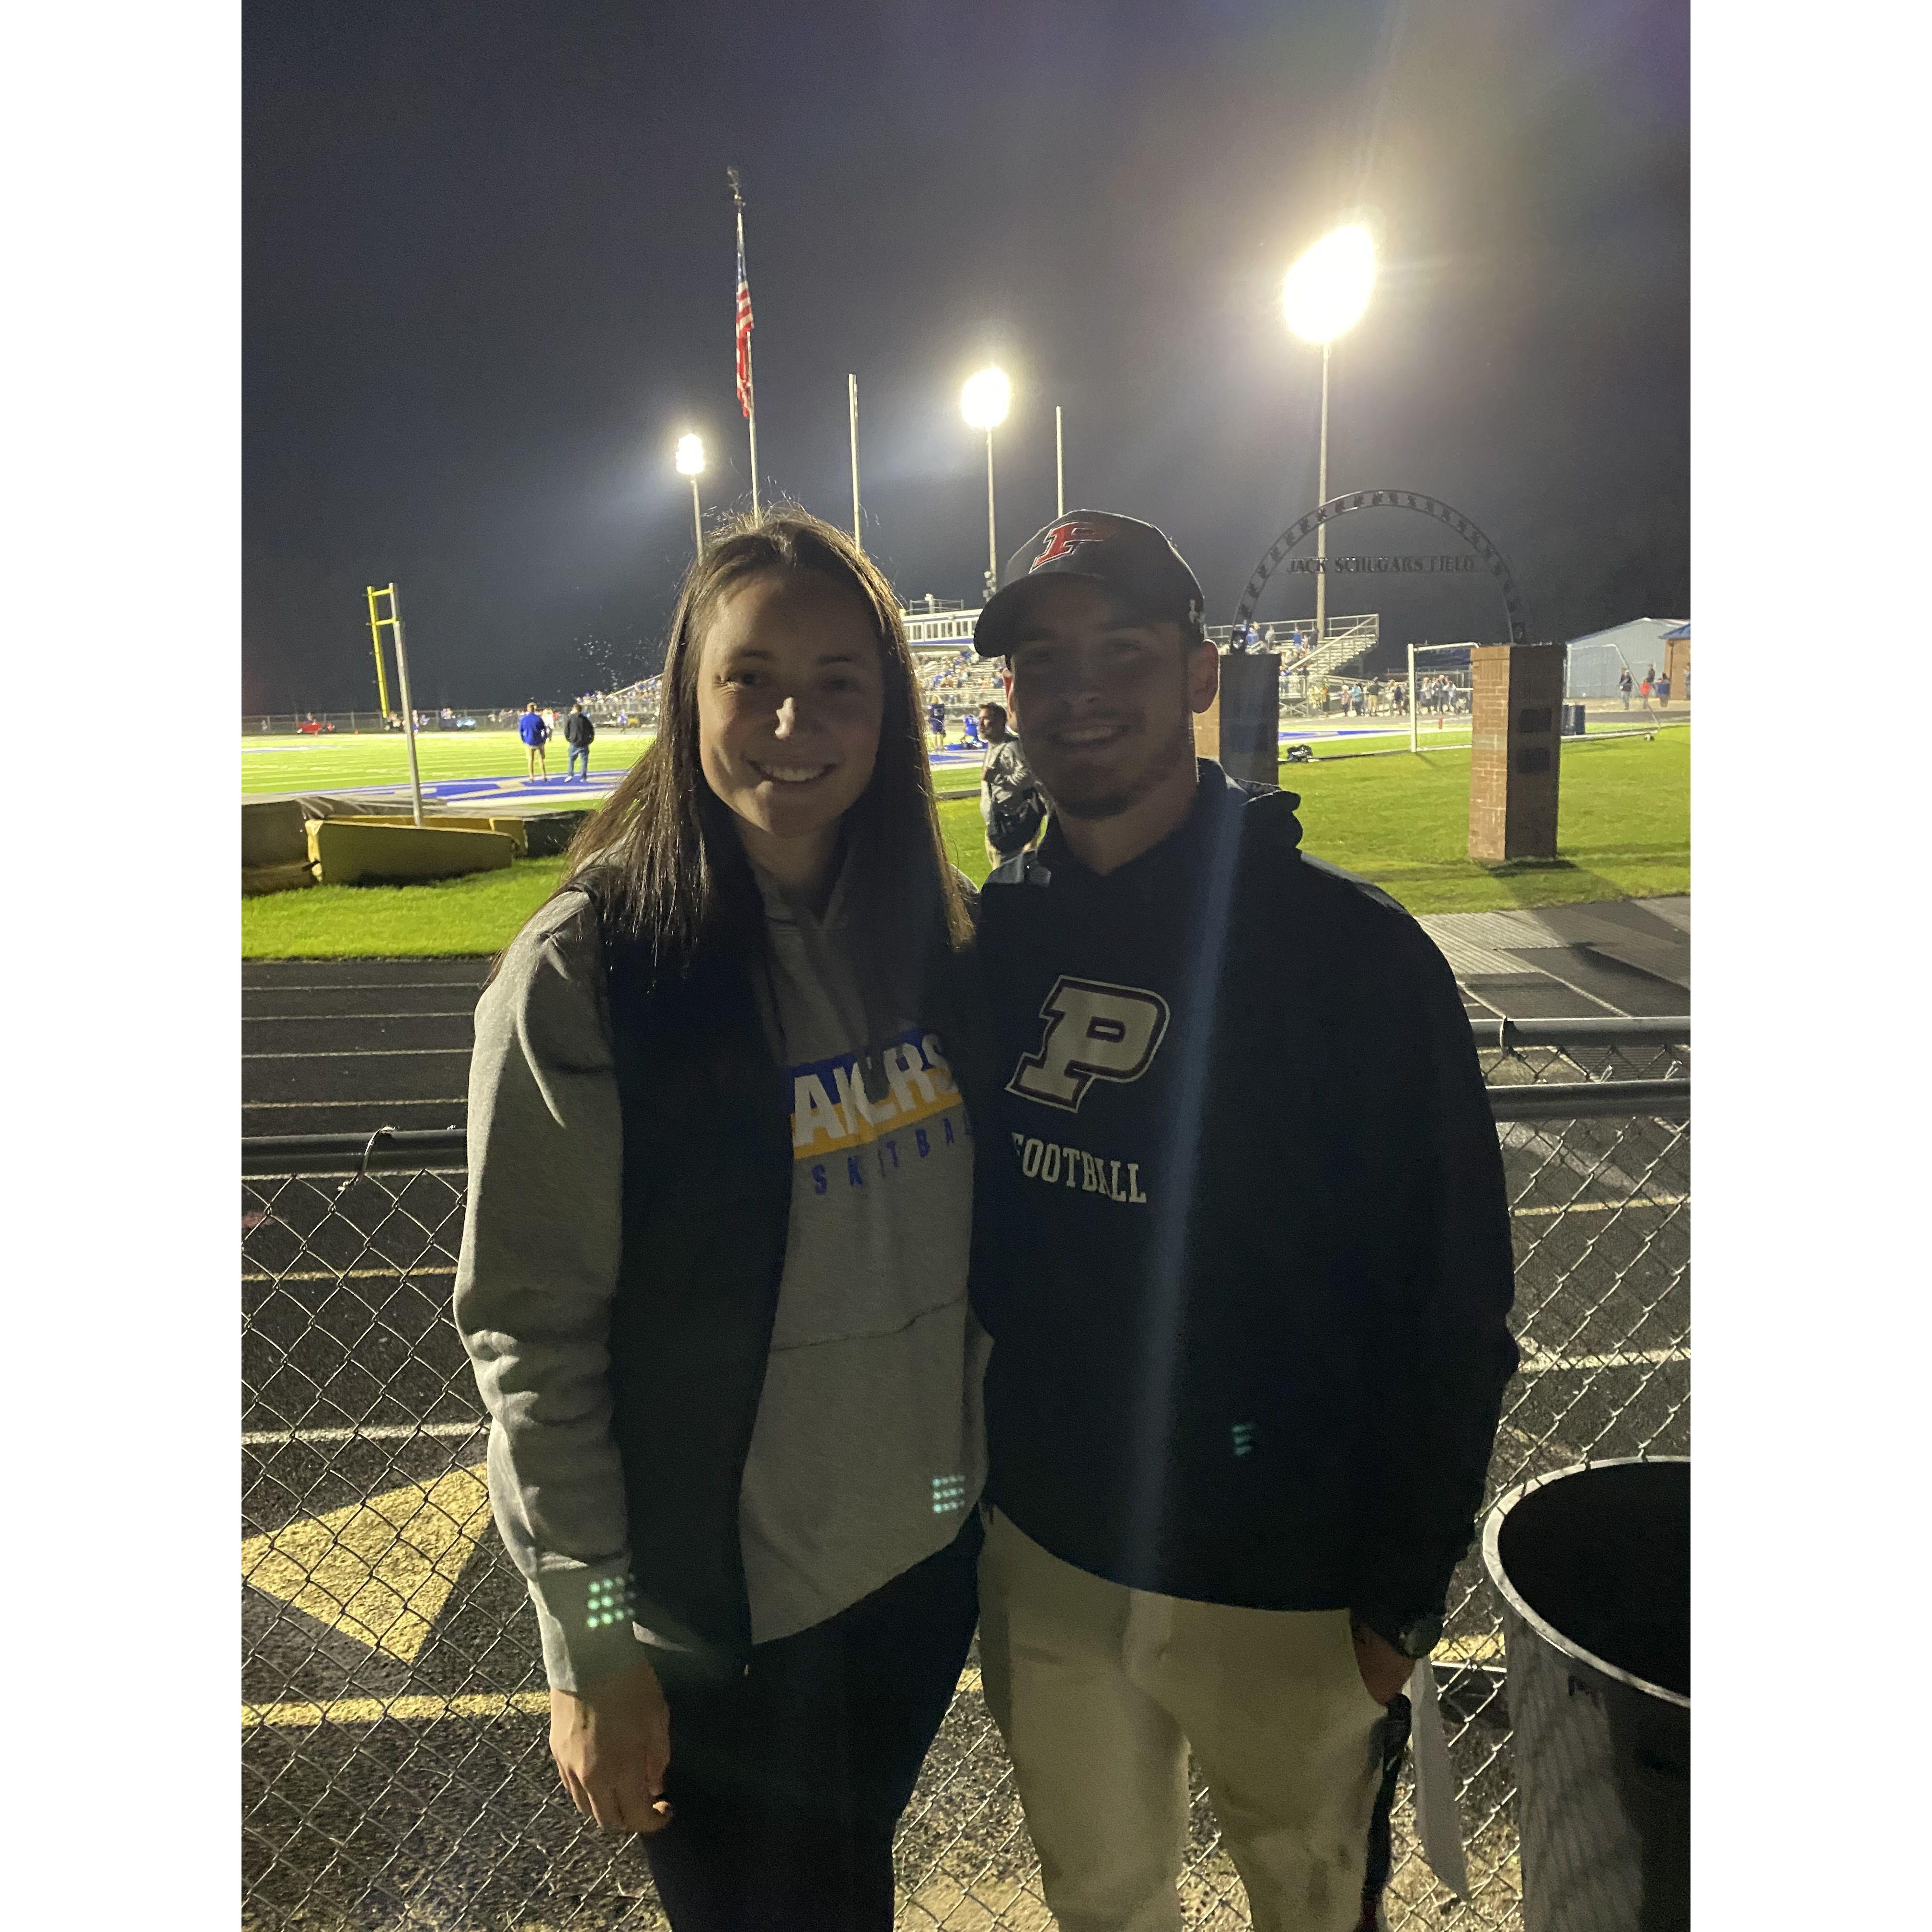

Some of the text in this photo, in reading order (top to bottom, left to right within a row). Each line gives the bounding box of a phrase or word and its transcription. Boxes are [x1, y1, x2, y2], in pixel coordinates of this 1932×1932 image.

[1287, 558, 1326, 574] JACK
[1427, 555, 1475, 572] FIELD
[1005, 975, 1170, 1114] P
